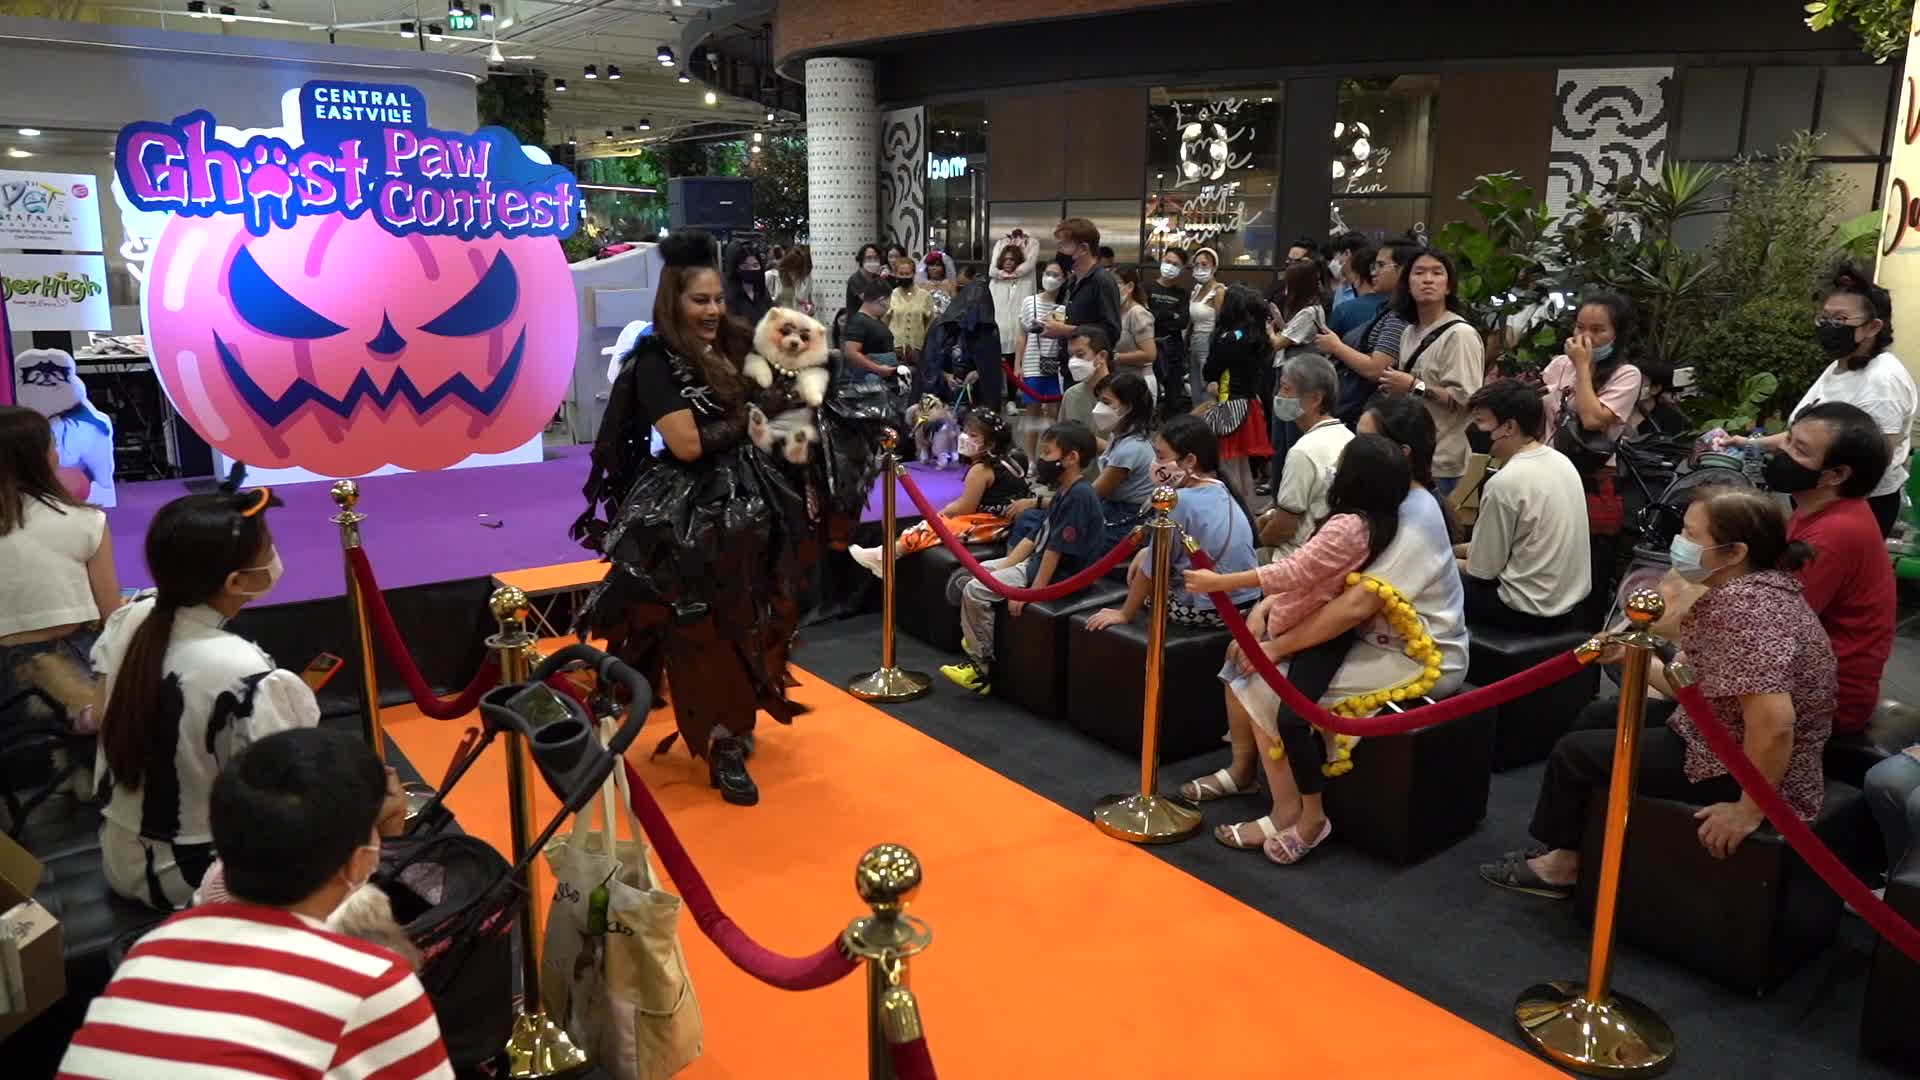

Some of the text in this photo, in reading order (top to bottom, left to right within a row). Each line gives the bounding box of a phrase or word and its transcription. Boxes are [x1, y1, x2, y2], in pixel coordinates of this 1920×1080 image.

[314, 87, 411, 107] CENTRAL
[315, 104, 412, 123] EASTVILLE
[1173, 97, 1243, 131] Love
[384, 128, 492, 180] Paw
[379, 180, 574, 232] Contest
